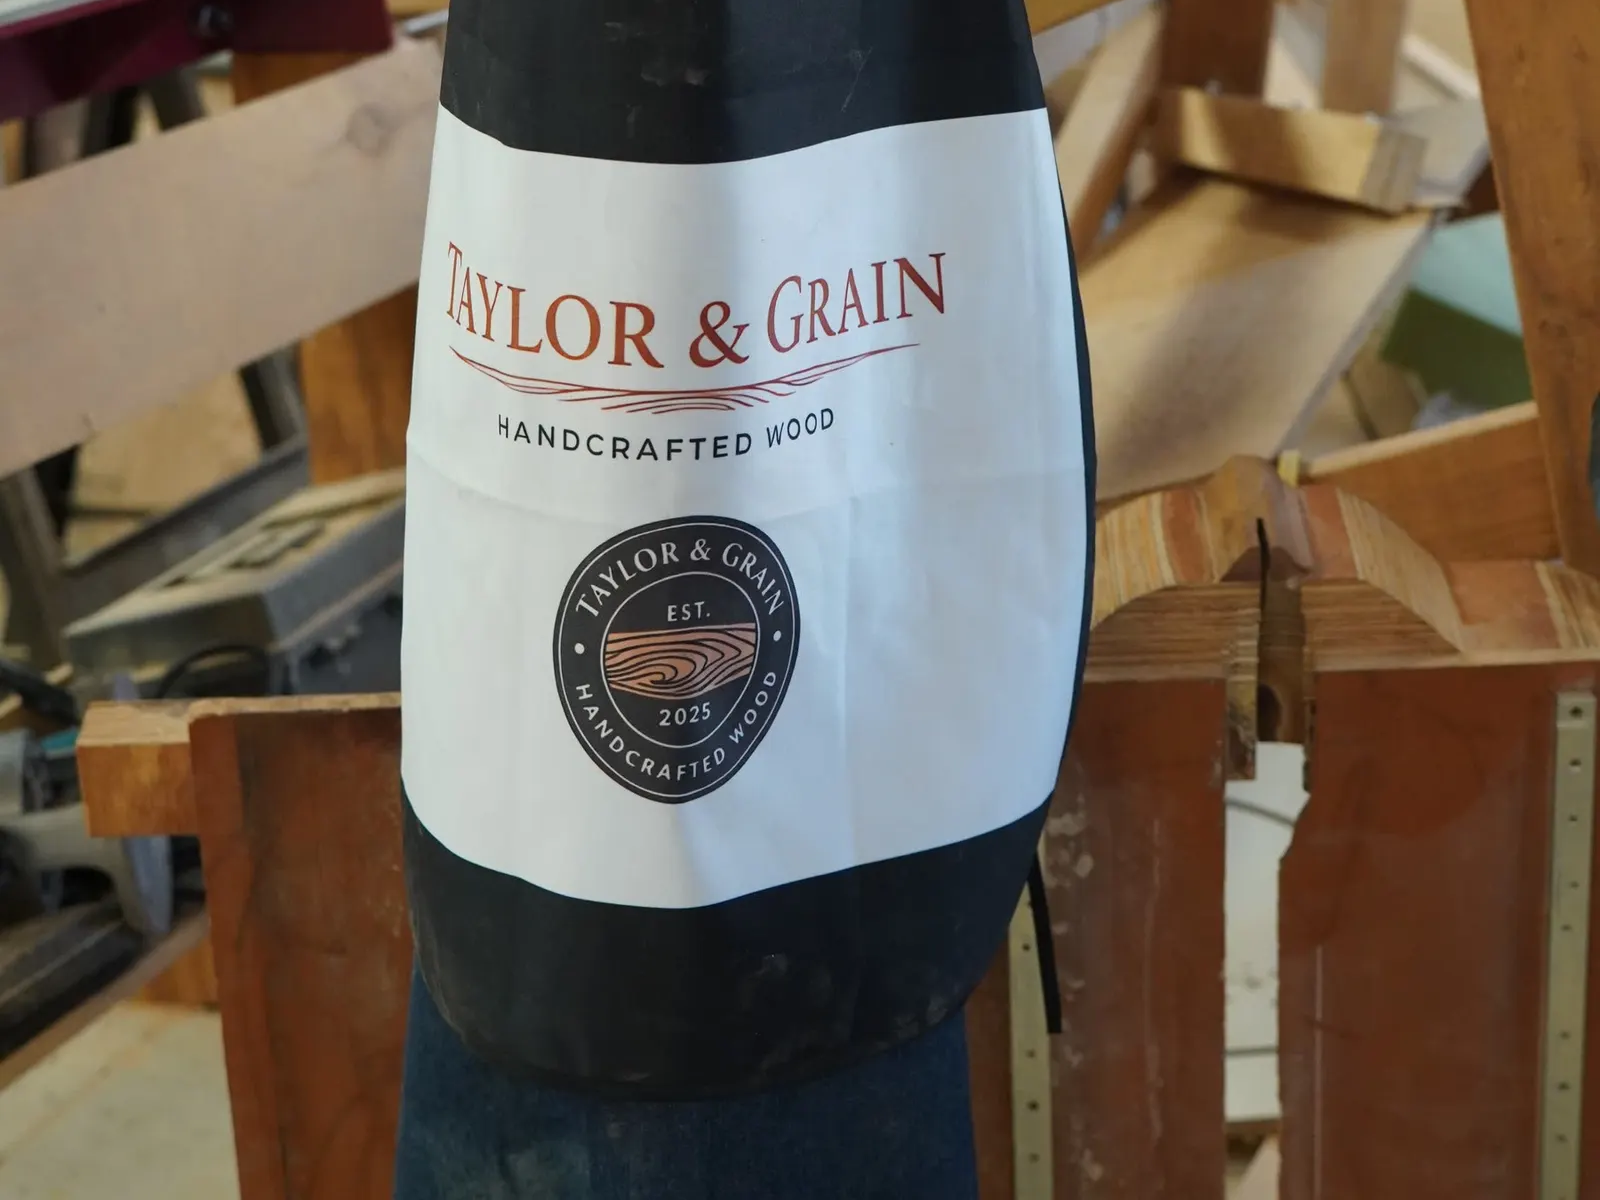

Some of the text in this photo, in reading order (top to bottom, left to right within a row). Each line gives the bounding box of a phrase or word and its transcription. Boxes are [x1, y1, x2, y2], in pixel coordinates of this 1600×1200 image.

[446, 240, 946, 369] TAYLOR & GRAIN
[497, 407, 835, 462] HANDCRAFTED WOOD
[575, 538, 785, 617] TAYLOR & GRAIN
[667, 601, 711, 622] EST.
[575, 671, 777, 781] HANDCRAFTED WOOD
[658, 702, 712, 726] 2025
